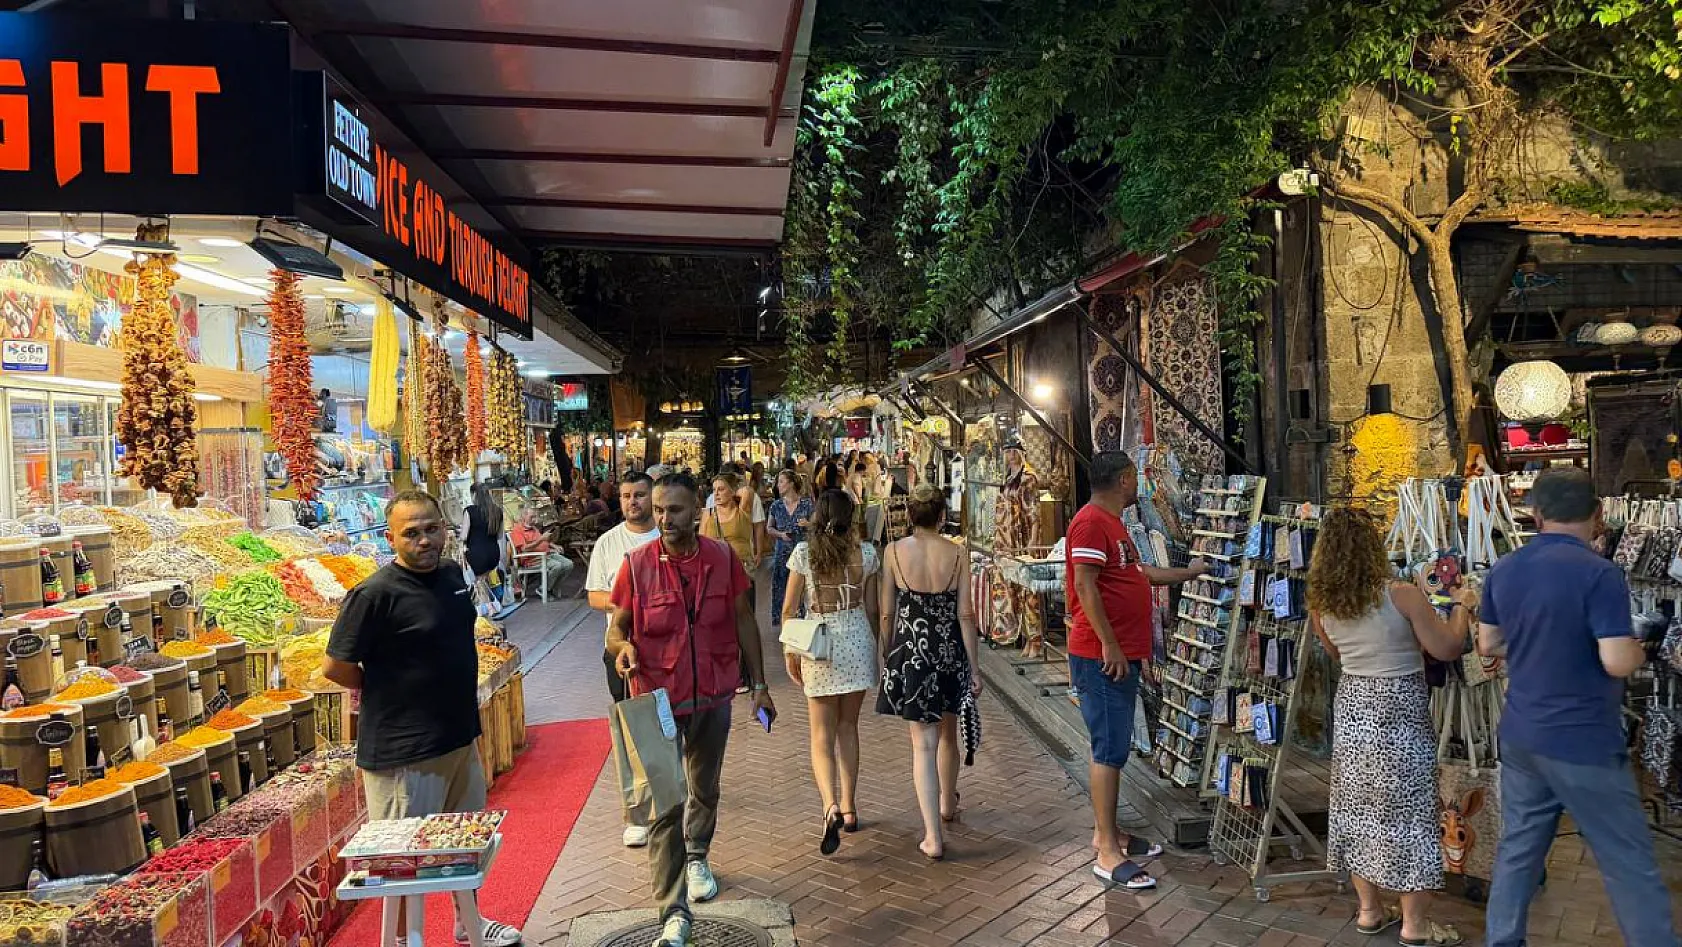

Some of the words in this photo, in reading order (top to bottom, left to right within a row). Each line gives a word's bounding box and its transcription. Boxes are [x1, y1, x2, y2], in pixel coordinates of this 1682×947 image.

[329, 145, 348, 192] OLD
[350, 158, 376, 211] TOWN
[413, 178, 446, 266] AND
[448, 210, 494, 305] TURKISH
[494, 249, 530, 324] DELIGHT
